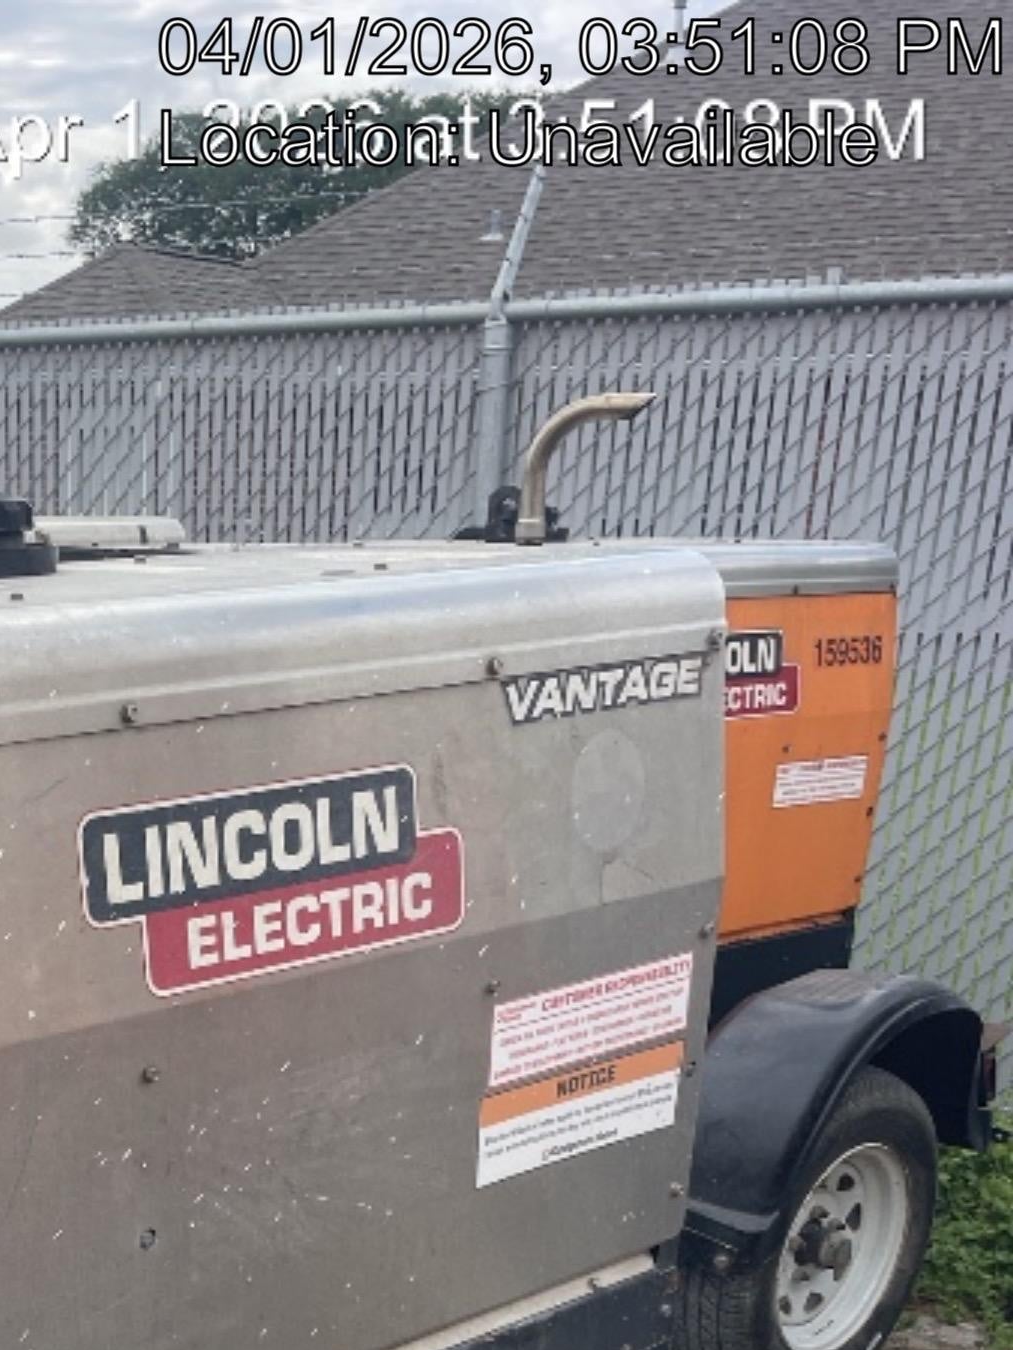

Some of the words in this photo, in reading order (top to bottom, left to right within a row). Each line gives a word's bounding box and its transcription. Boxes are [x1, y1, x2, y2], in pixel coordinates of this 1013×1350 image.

[814, 635, 884, 667] 159536
[505, 657, 703, 722] VANTAGE
[723, 682, 787, 712] CTRIC
[102, 785, 401, 905] LINCOLN
[187, 871, 433, 970] ELECTRIC
[556, 1064, 617, 1099] NOTICE
